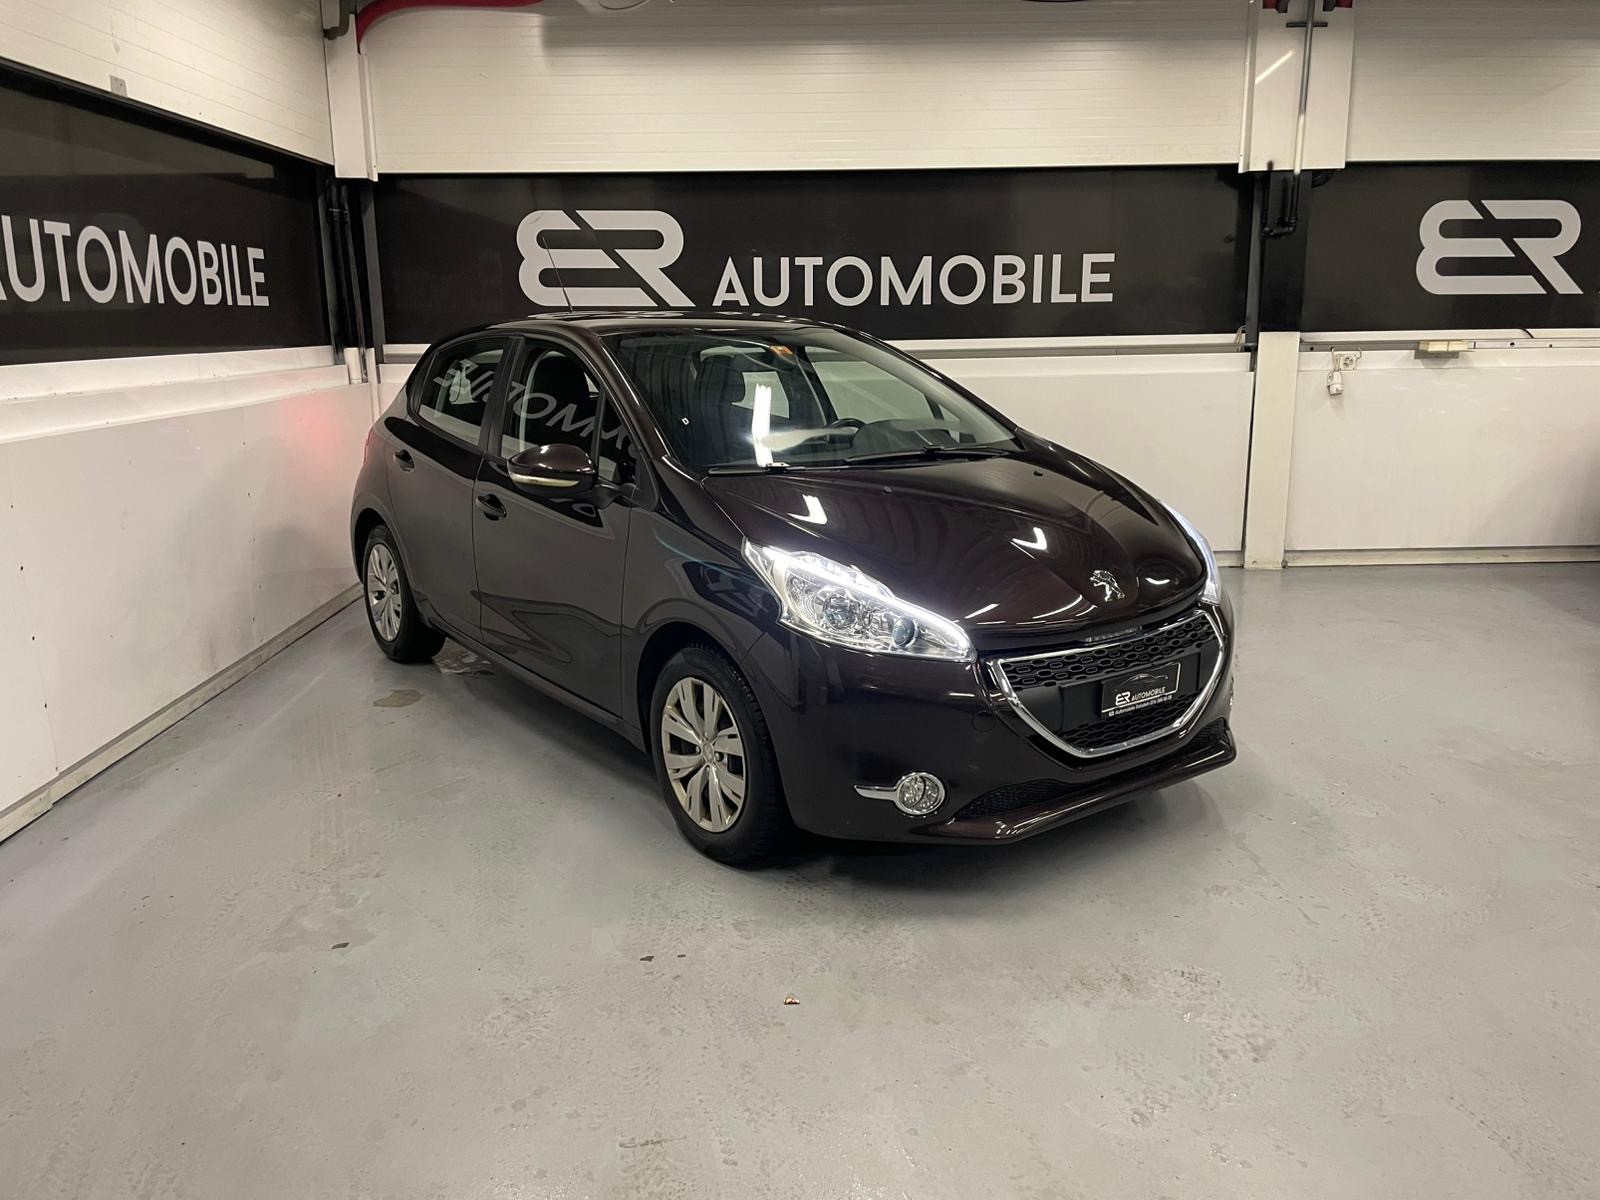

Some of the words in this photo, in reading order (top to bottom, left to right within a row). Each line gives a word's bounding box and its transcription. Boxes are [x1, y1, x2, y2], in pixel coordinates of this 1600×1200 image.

[0, 214, 270, 307] UTOMOBILE
[516, 209, 697, 307] ER
[711, 252, 1116, 308] AUTOMOBILE
[1415, 199, 1584, 295] ER
[1115, 691, 1130, 705] ER
[1131, 686, 1165, 701] AUTOMOBILE
